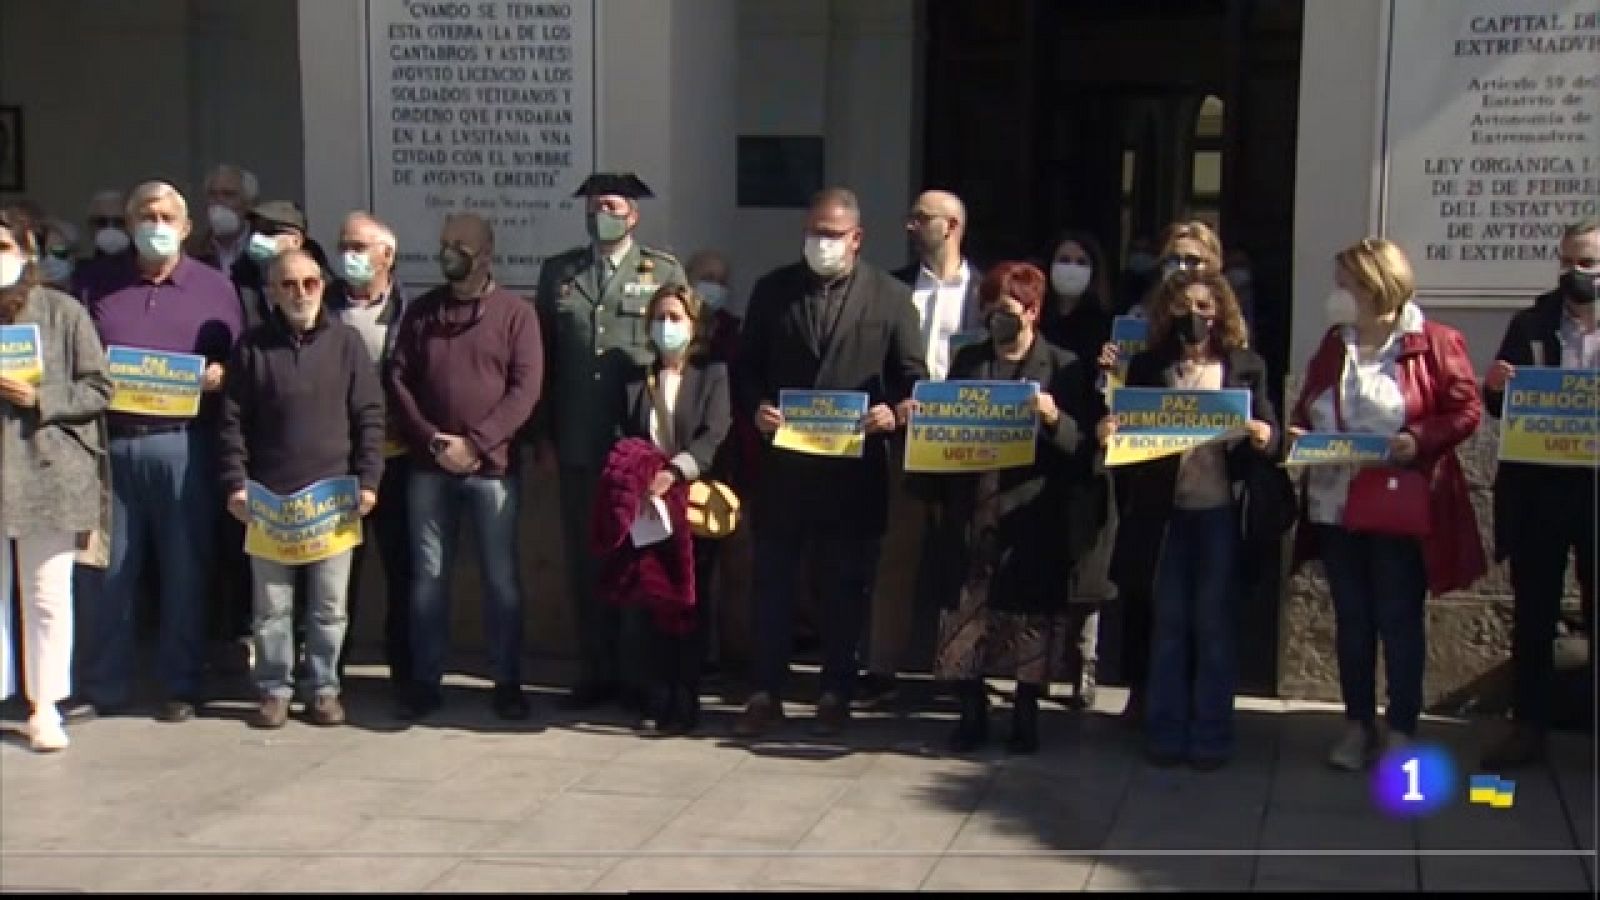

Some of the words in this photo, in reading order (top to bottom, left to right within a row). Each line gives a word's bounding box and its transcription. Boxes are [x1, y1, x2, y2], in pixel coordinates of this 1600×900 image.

[478, 3, 496, 19] SE
[389, 24, 421, 40] ESTA
[427, 24, 483, 40] GVERRA
[517, 24, 534, 40] DE
[542, 24, 571, 40] LOS
[1470, 14, 1565, 33] CAPITAL
[389, 44, 479, 60] CANTABROS
[484, 45, 493, 60] Y
[531, 68, 540, 81] A
[545, 66, 573, 82] LOS
[391, 86, 471, 102] SOLDADOS
[475, 87, 557, 104] VETERANOS
[563, 88, 571, 104] Y
[459, 108, 489, 124] QVE
[392, 128, 413, 145] EN
[422, 129, 443, 145] LA
[452, 129, 531, 146] LVSITANIA
[539, 130, 571, 146] VNA
[392, 149, 448, 165] CIVDAD
[452, 150, 484, 166] CON
[489, 151, 506, 166] EL
[513, 151, 572, 167] NOMBRE
[1424, 158, 1464, 175] LEY
[392, 169, 413, 185] DE
[1432, 179, 1458, 196] DE
[1491, 179, 1518, 196] DE
[1440, 200, 1481, 217] DEL
[1490, 200, 1596, 217] ESTATVTO
[1447, 223, 1473, 240] DE
[1482, 222, 1562, 240] AVTONO
[1426, 245, 1451, 260] DE
[1460, 245, 1561, 260] EXTREMA
[957, 385, 992, 402] PAZ
[914, 400, 1034, 419] DEMOCRACIA
[1161, 394, 1199, 411] PAZ
[1116, 410, 1245, 427] DEMOCRACIA
[912, 424, 924, 441] Y
[926, 424, 1034, 442] SOLIDARIDAD
[943, 447, 975, 460] UGT
